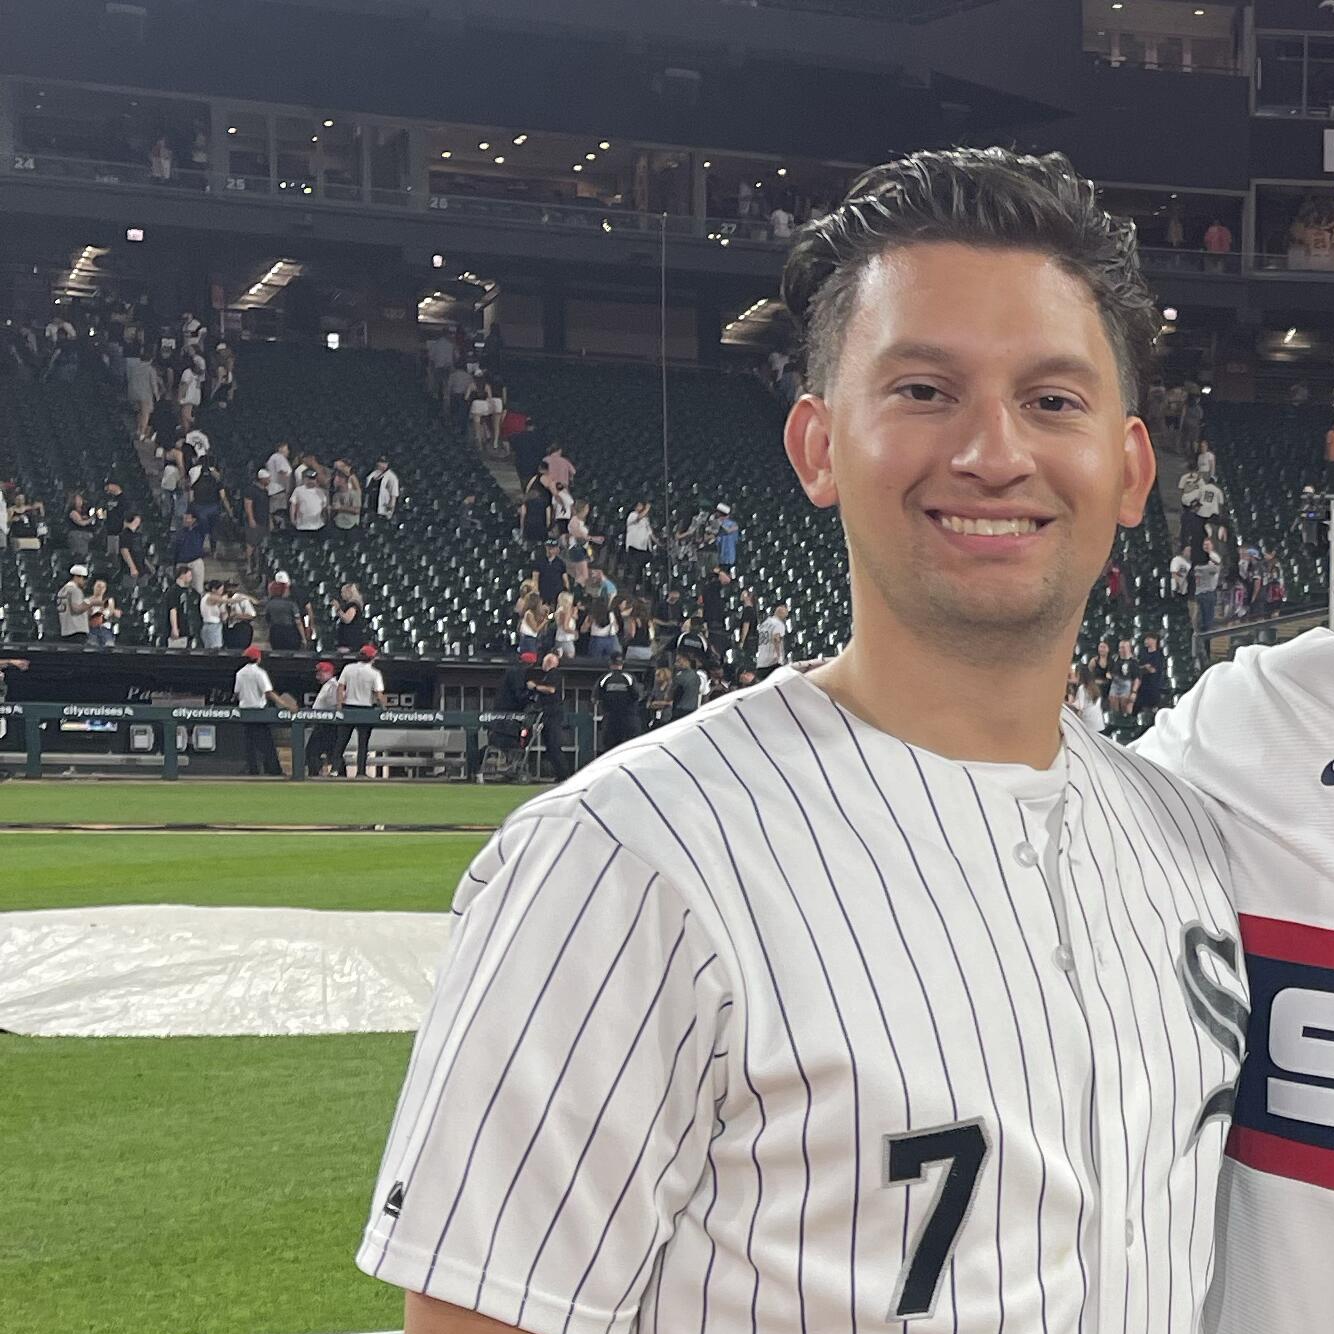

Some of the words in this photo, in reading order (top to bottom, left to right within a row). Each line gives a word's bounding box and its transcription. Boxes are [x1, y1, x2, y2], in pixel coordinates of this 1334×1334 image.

[14, 157, 35, 169] 24
[63, 704, 123, 719] citycruises
[172, 706, 231, 719] citycruises
[278, 709, 334, 721] citycruises
[380, 710, 434, 723] citycruises
[882, 1115, 993, 1322] 7
